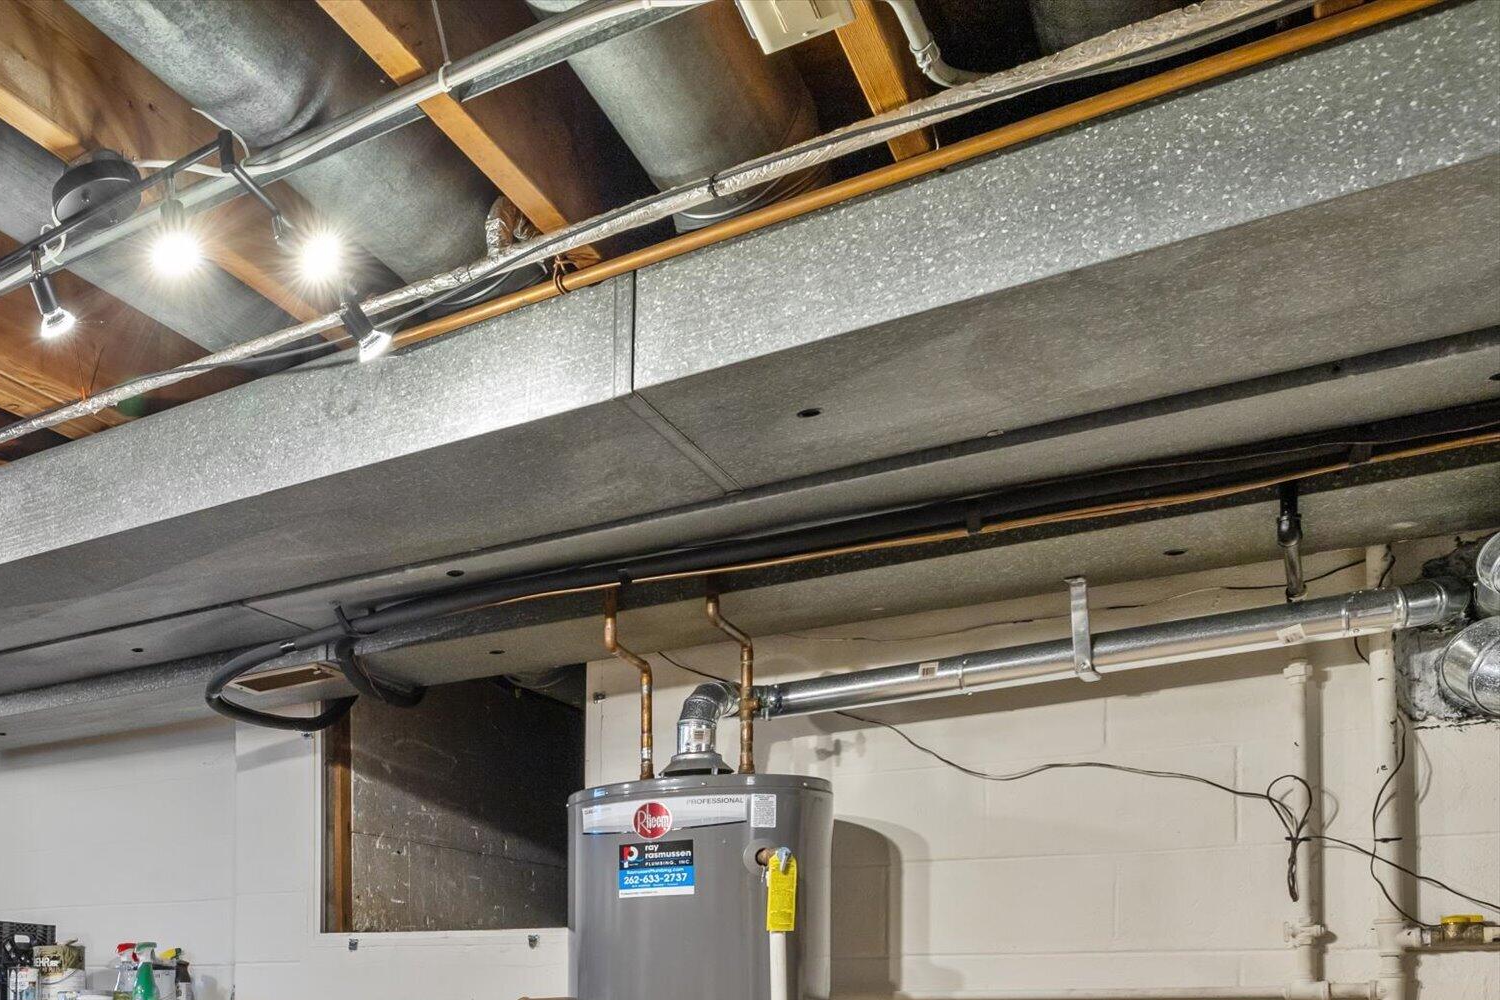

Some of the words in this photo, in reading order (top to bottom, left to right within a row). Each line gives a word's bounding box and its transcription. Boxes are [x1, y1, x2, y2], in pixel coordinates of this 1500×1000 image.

[637, 803, 670, 833] Rheem
[644, 850, 692, 859] rasmussen
[623, 873, 688, 885] 262-633-2737
